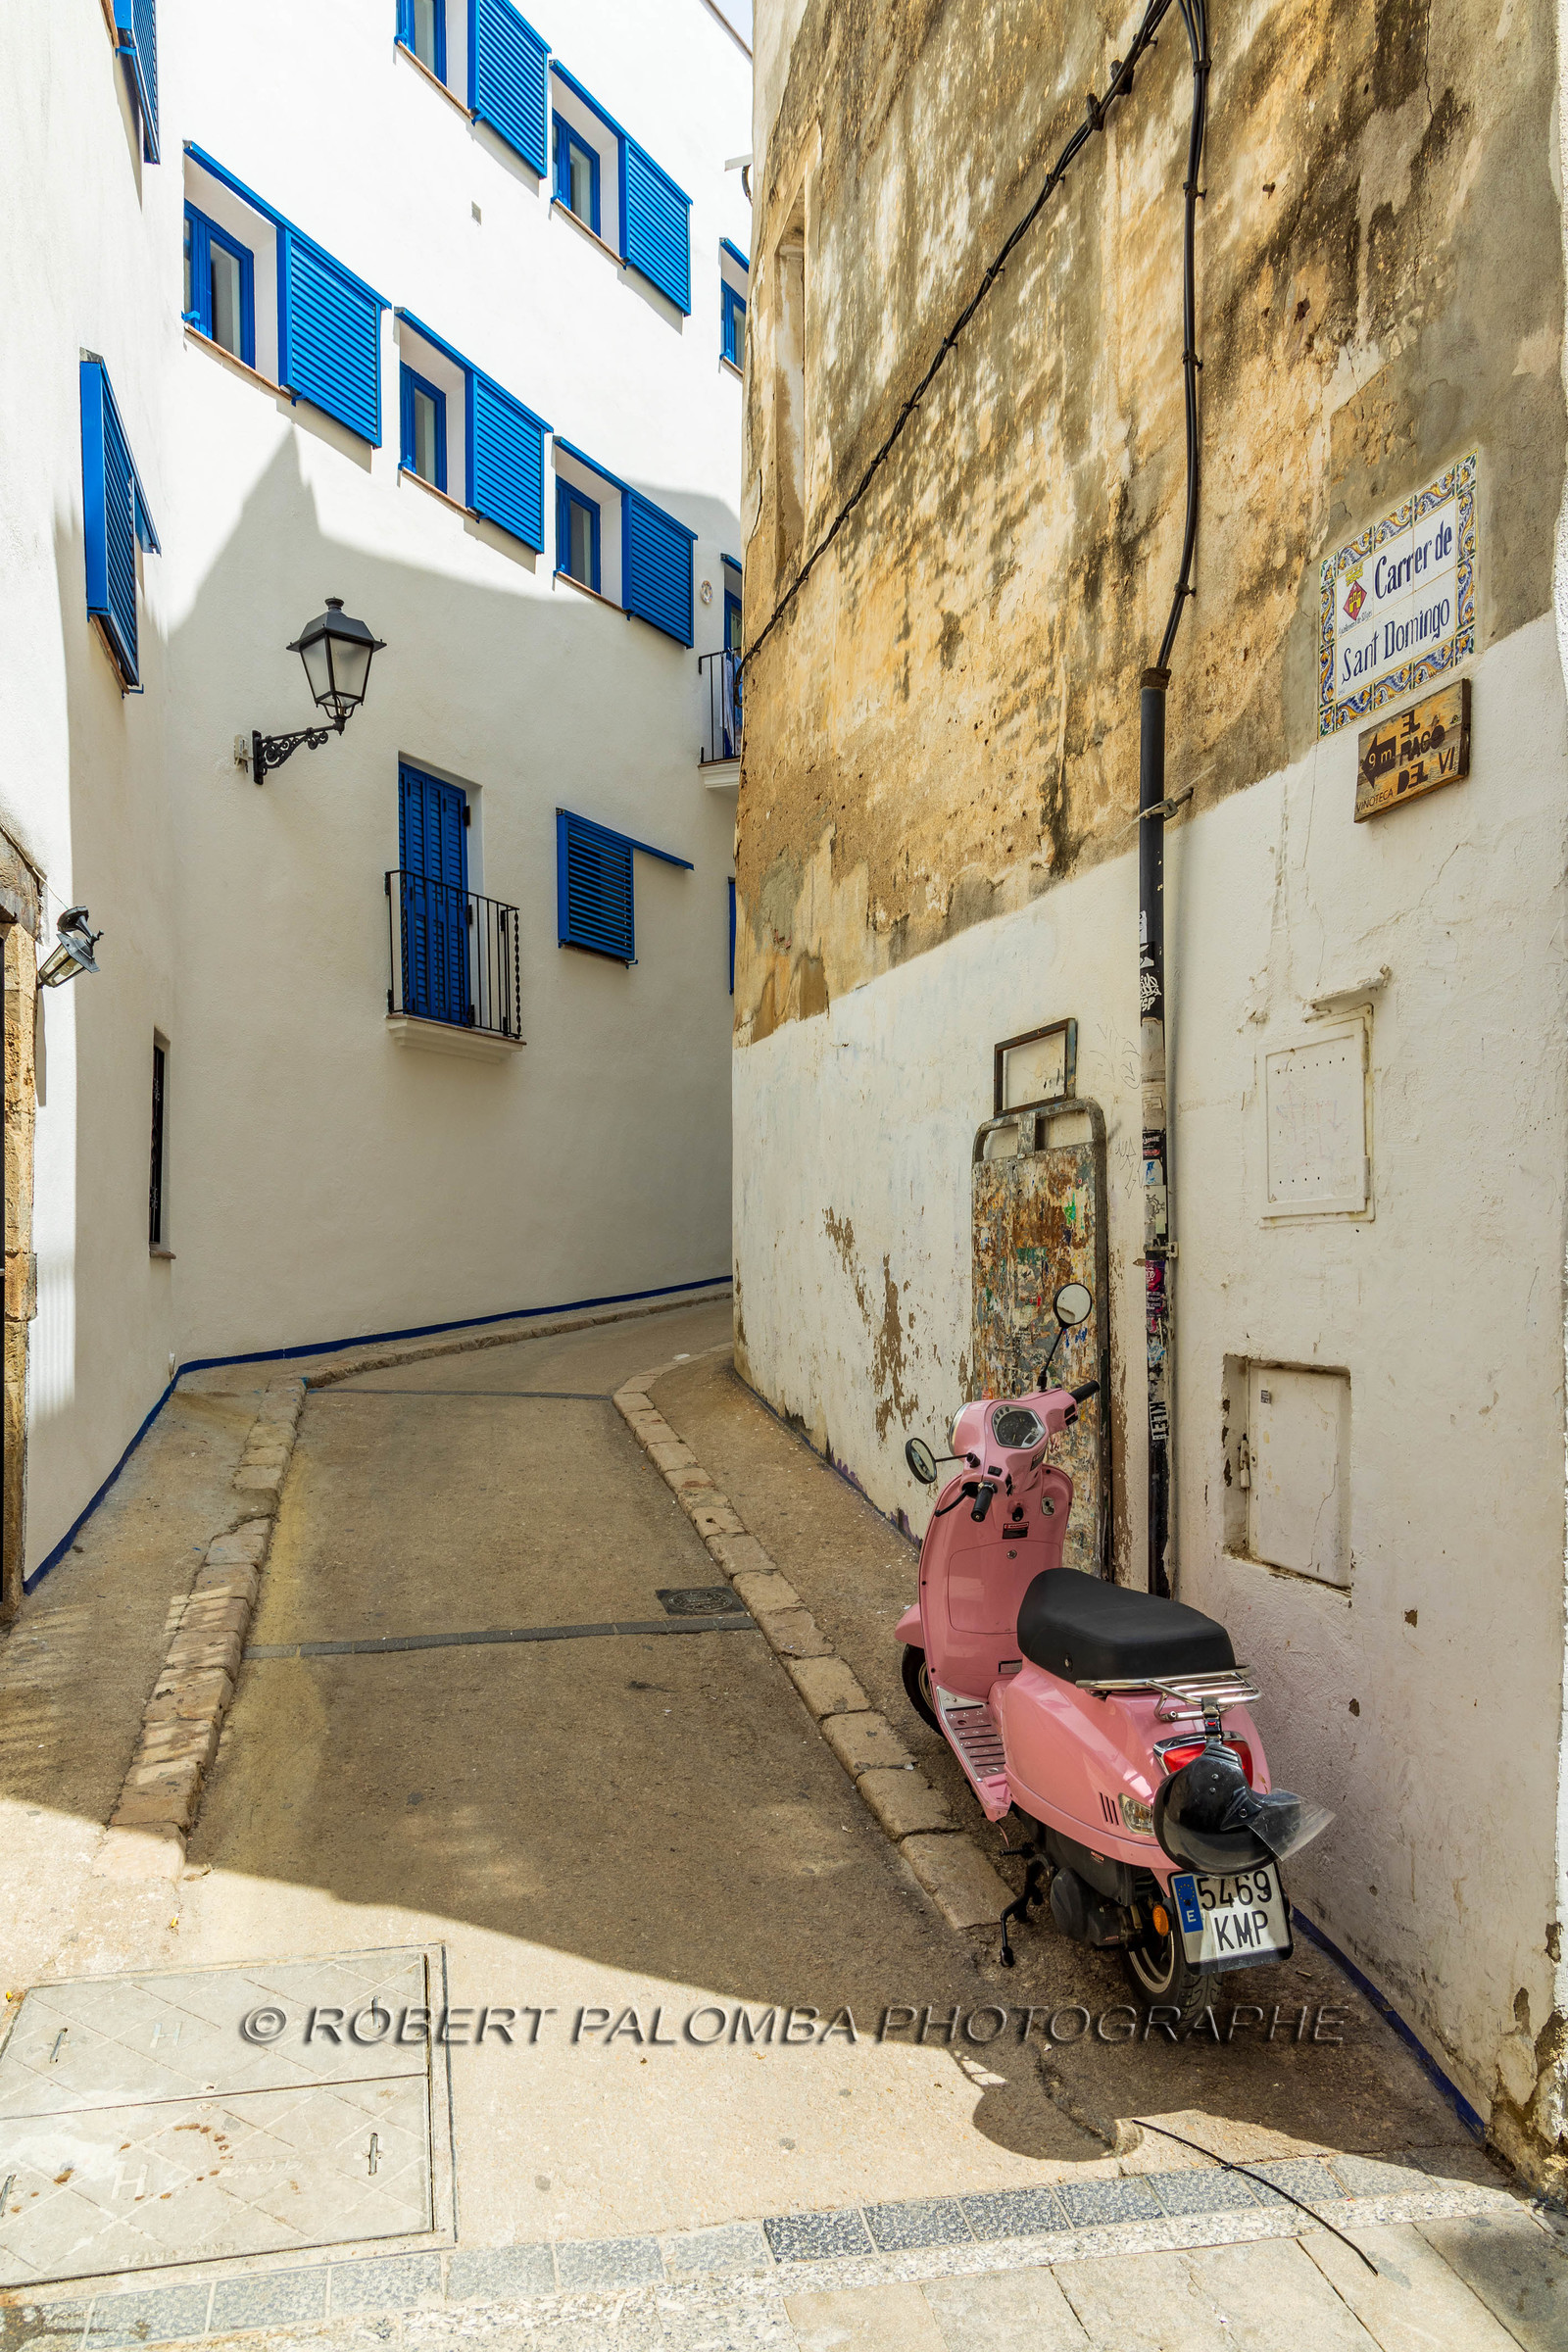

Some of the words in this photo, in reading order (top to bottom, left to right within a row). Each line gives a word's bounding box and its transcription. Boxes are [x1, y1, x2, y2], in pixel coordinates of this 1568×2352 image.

[1374, 540, 1432, 600] Carrer
[1435, 520, 1452, 562] de
[1341, 630, 1380, 685] Sant
[1383, 598, 1450, 661] Domingo
[1399, 709, 1421, 739] EL
[1368, 753, 1377, 768] 9
[1396, 760, 1429, 796] DEL
[1439, 746, 1455, 774] VI
[1356, 788, 1394, 812] VINOTECA
[1150, 1400, 1170, 1437] KLET
[1197, 1870, 1272, 1911] 5469
[1187, 1910, 1197, 1923] E
[1214, 1910, 1269, 1951] KMP
